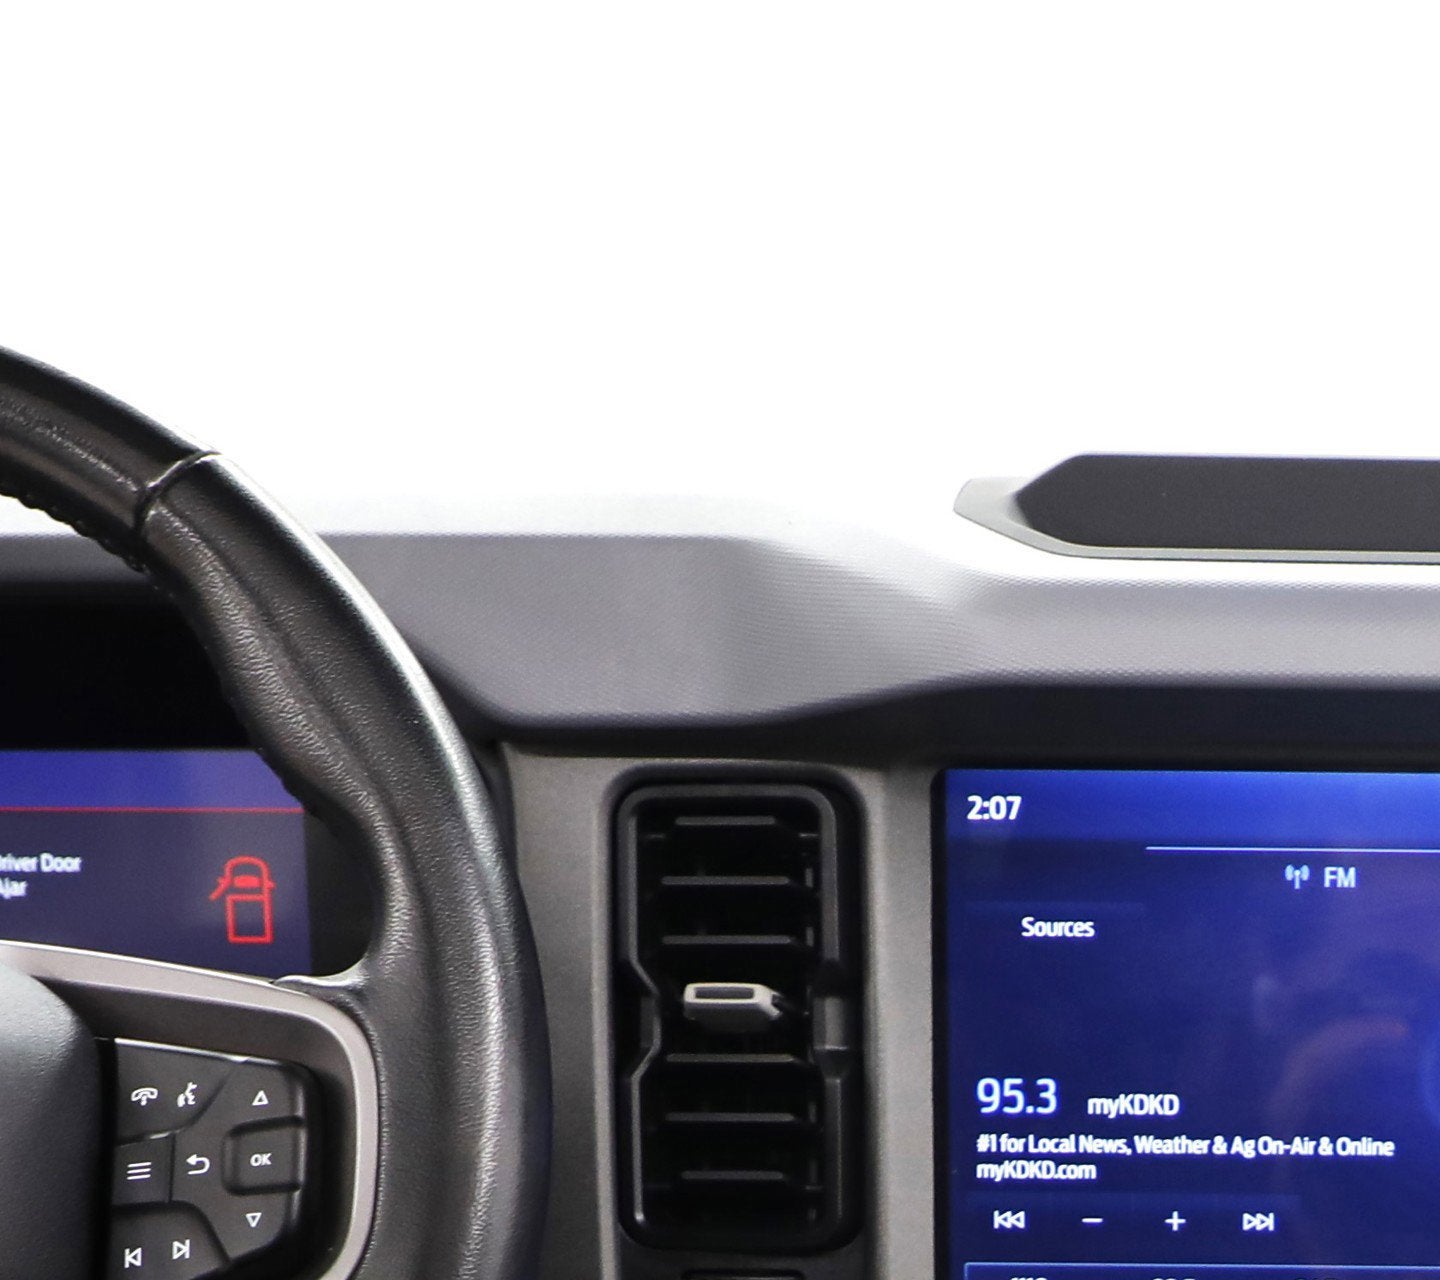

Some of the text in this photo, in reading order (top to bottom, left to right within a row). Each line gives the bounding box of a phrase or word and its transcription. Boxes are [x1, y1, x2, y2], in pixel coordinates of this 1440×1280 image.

[966, 795, 1023, 824] 2:07
[41, 852, 83, 874] Door
[1323, 866, 1361, 889] FM
[1021, 916, 1096, 939] Sources
[975, 1077, 1059, 1115] 95.3
[1087, 1093, 1181, 1120] myKDKD
[975, 1132, 1396, 1160] #1 for Local News, Weather & Ag On-Air & Online
[249, 1152, 272, 1167] OK
[976, 1159, 1098, 1183] myKDKD.com
